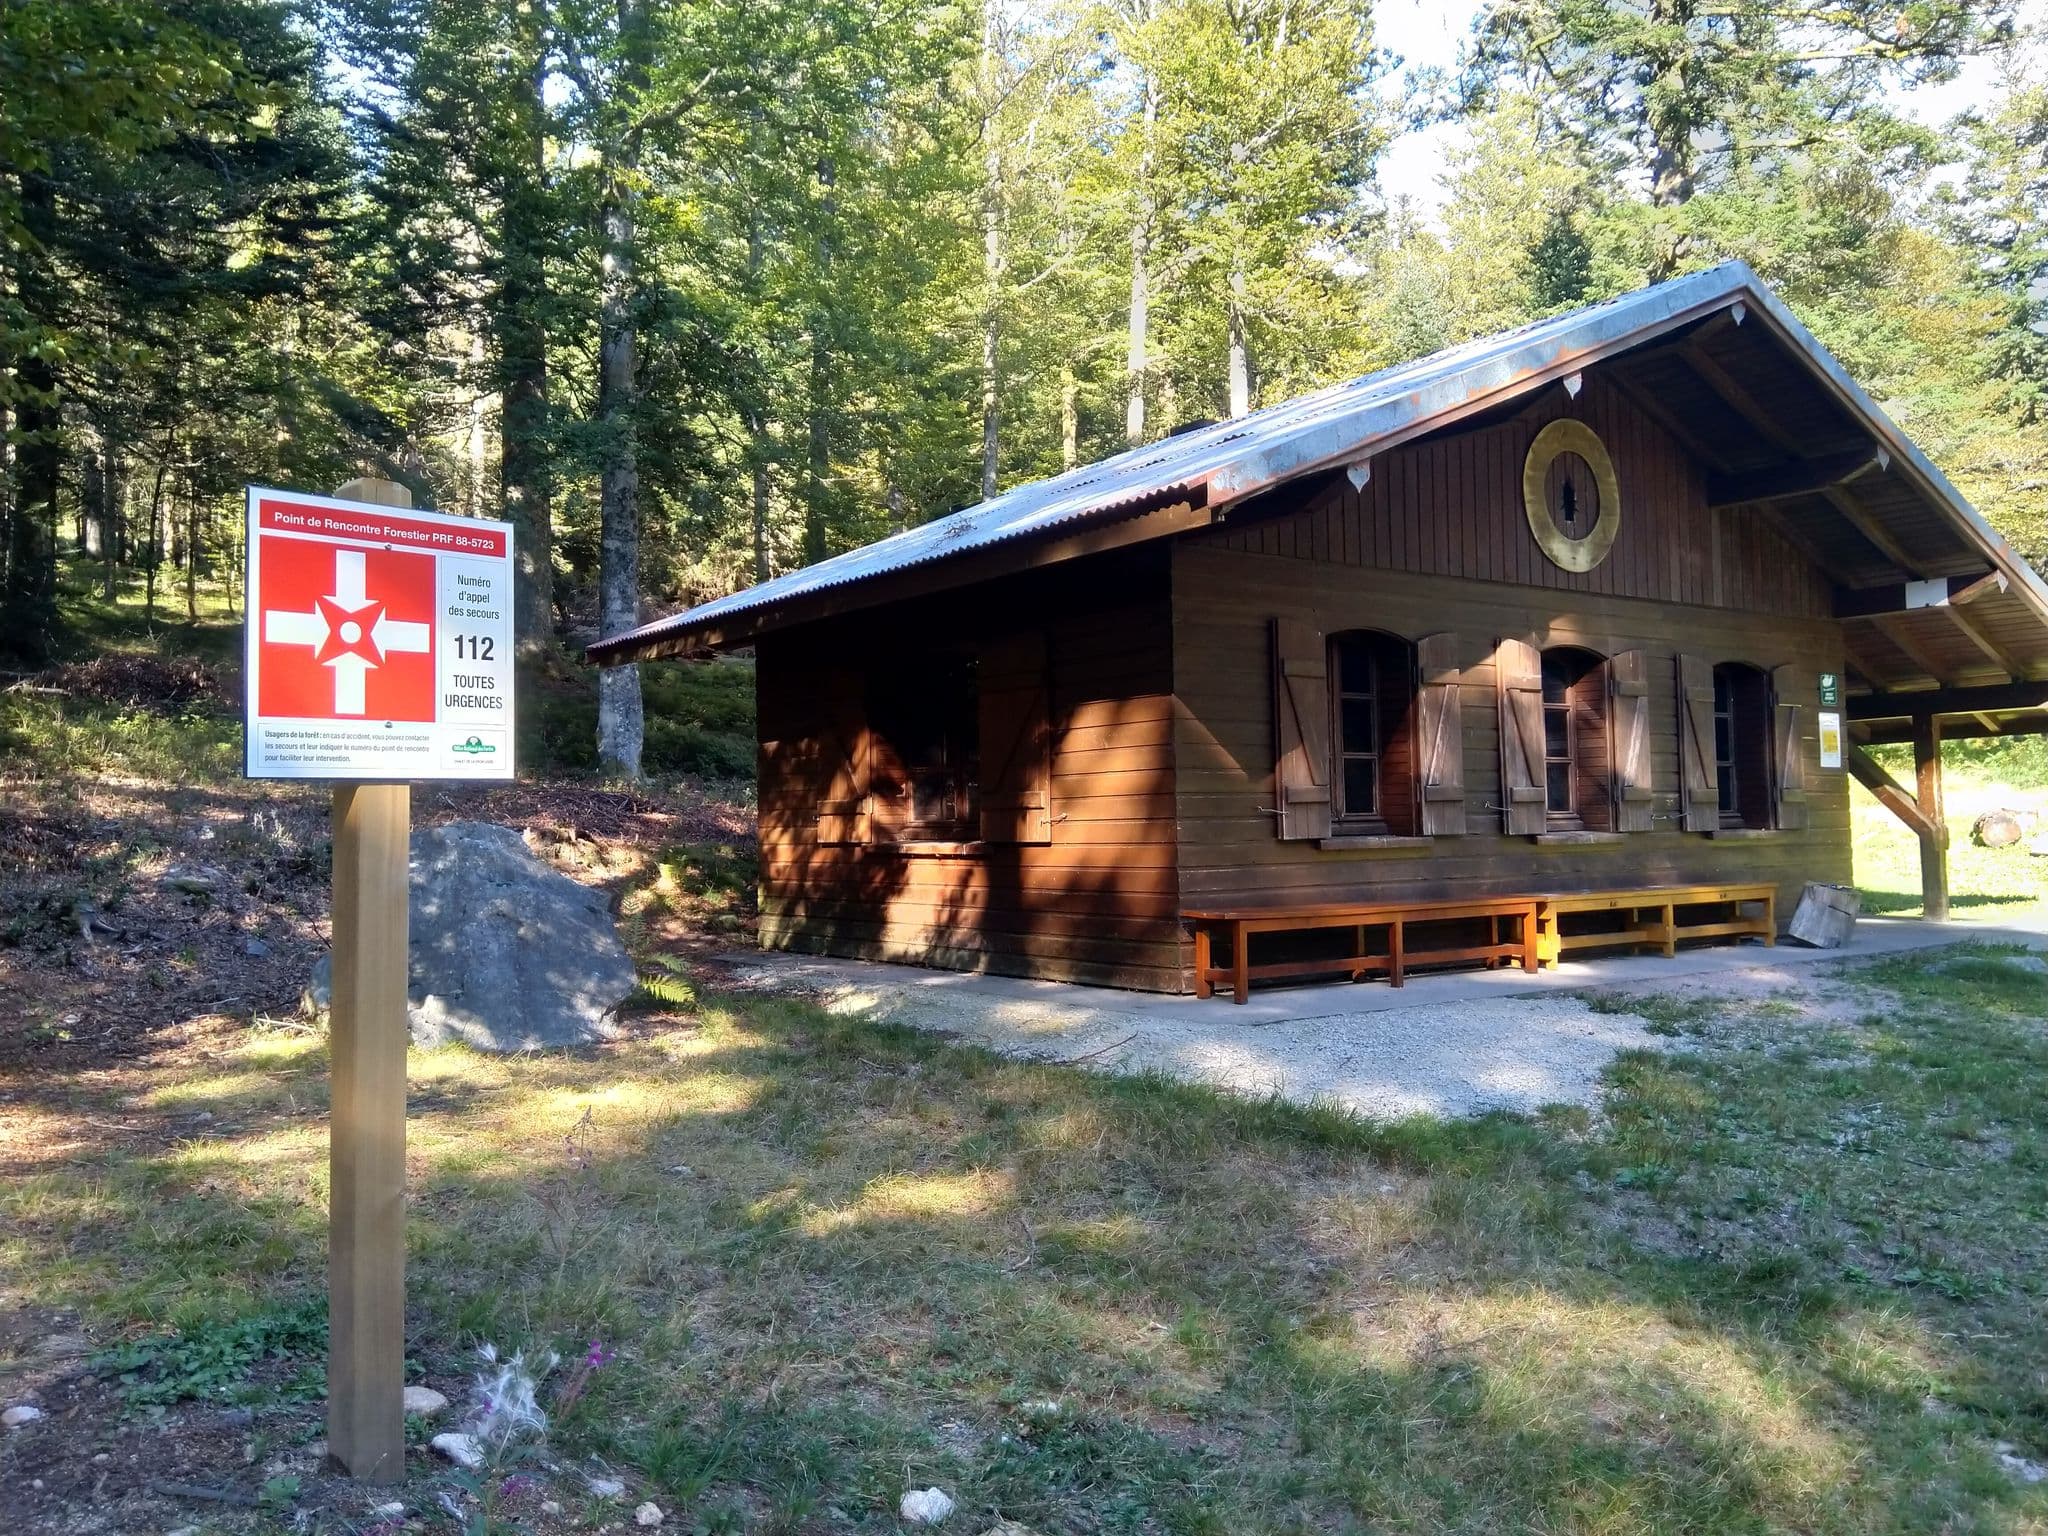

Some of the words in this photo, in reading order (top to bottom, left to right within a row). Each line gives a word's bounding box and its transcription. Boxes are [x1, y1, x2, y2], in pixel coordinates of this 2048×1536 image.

[275, 512, 304, 524] Point
[307, 516, 321, 528] de
[324, 518, 381, 535] Rencontre
[384, 526, 430, 541] Forestier
[432, 533, 453, 544] PRF
[455, 537, 494, 549] 88-5723
[458, 574, 491, 588] Numéro
[458, 591, 490, 604] d'appel
[448, 605, 464, 616] des
[466, 607, 500, 620] secours
[454, 634, 494, 661] 112
[453, 674, 494, 690] TOUTES
[445, 693, 503, 710] URGENCES
[265, 730, 290, 739] Usagers
[265, 742, 274, 750] les
[319, 743, 343, 752] indiquer
[265, 754, 279, 762] pour
[279, 753, 301, 761] faciliter
